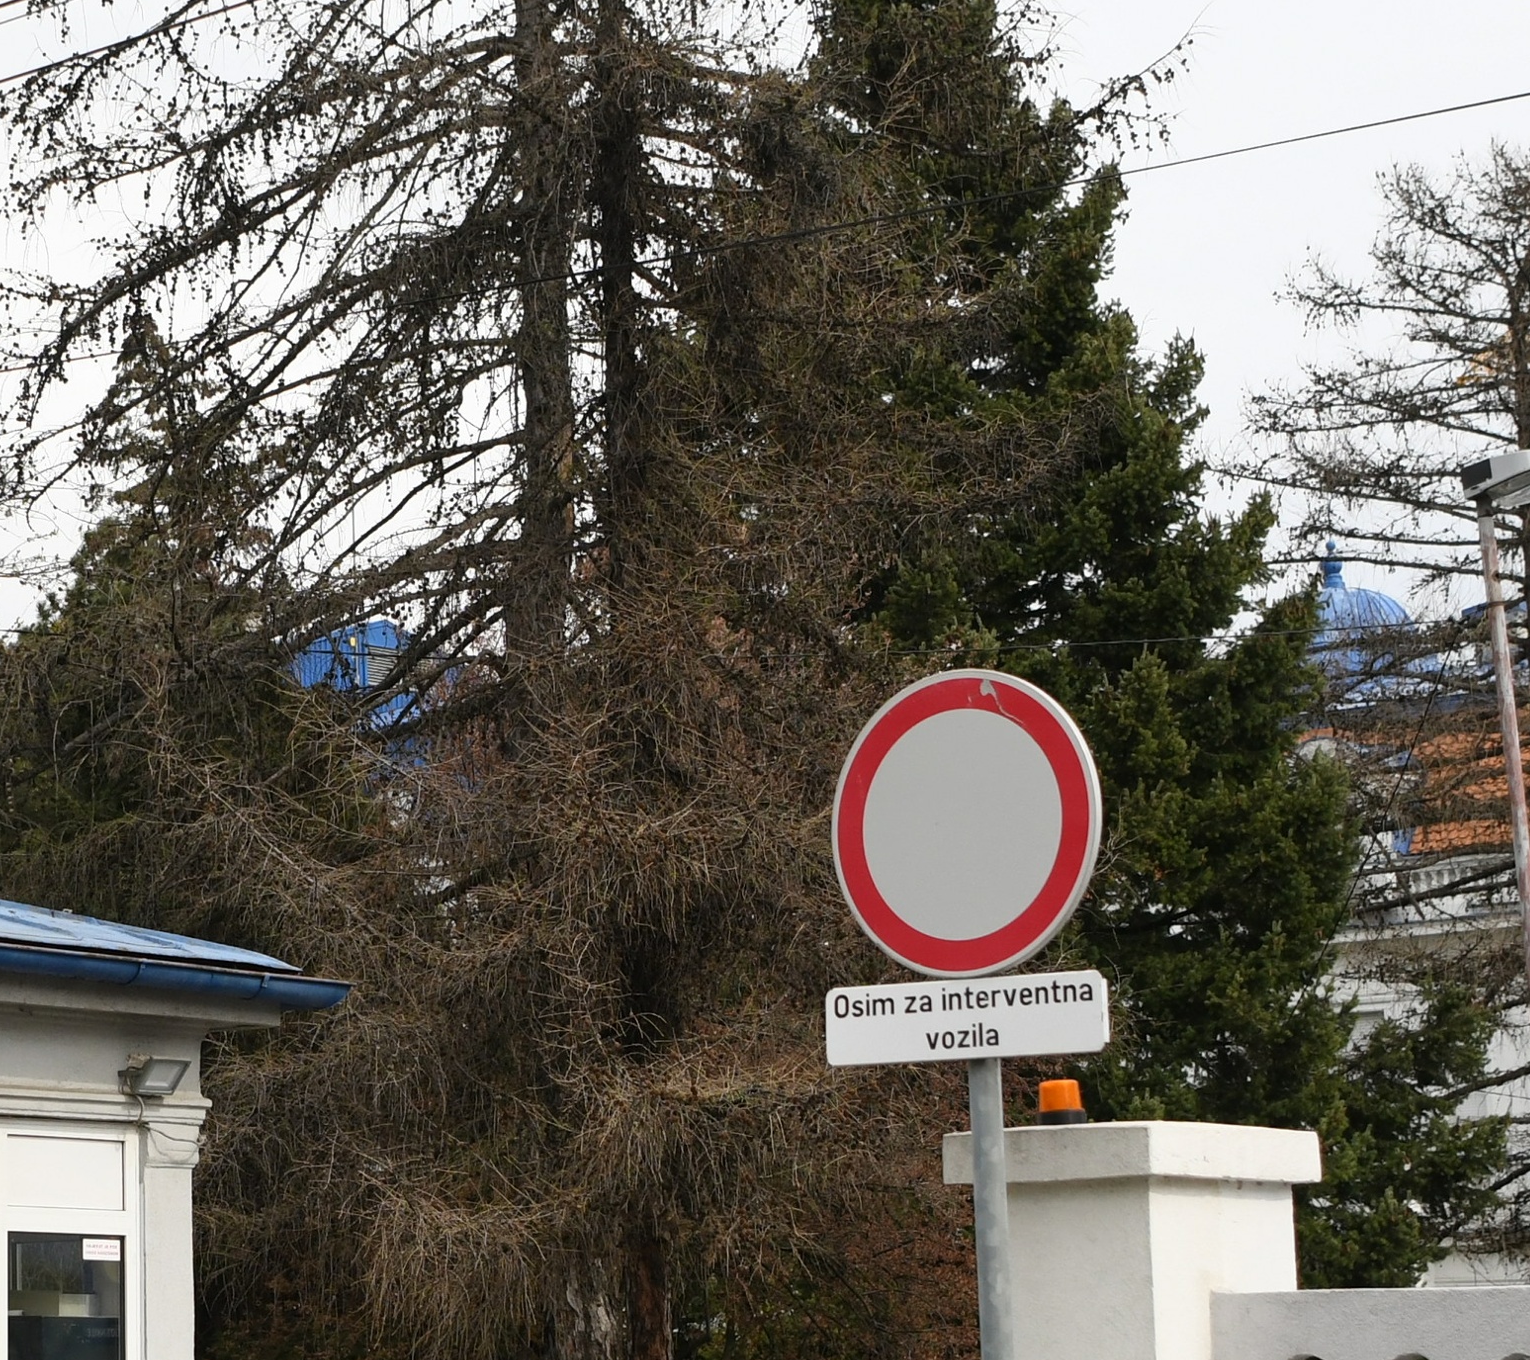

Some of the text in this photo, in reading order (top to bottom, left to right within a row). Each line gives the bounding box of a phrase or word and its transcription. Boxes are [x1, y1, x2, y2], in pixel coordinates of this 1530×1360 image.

[834, 980, 1093, 1018] Osim za interventna
[925, 1023, 1000, 1050] vozila
